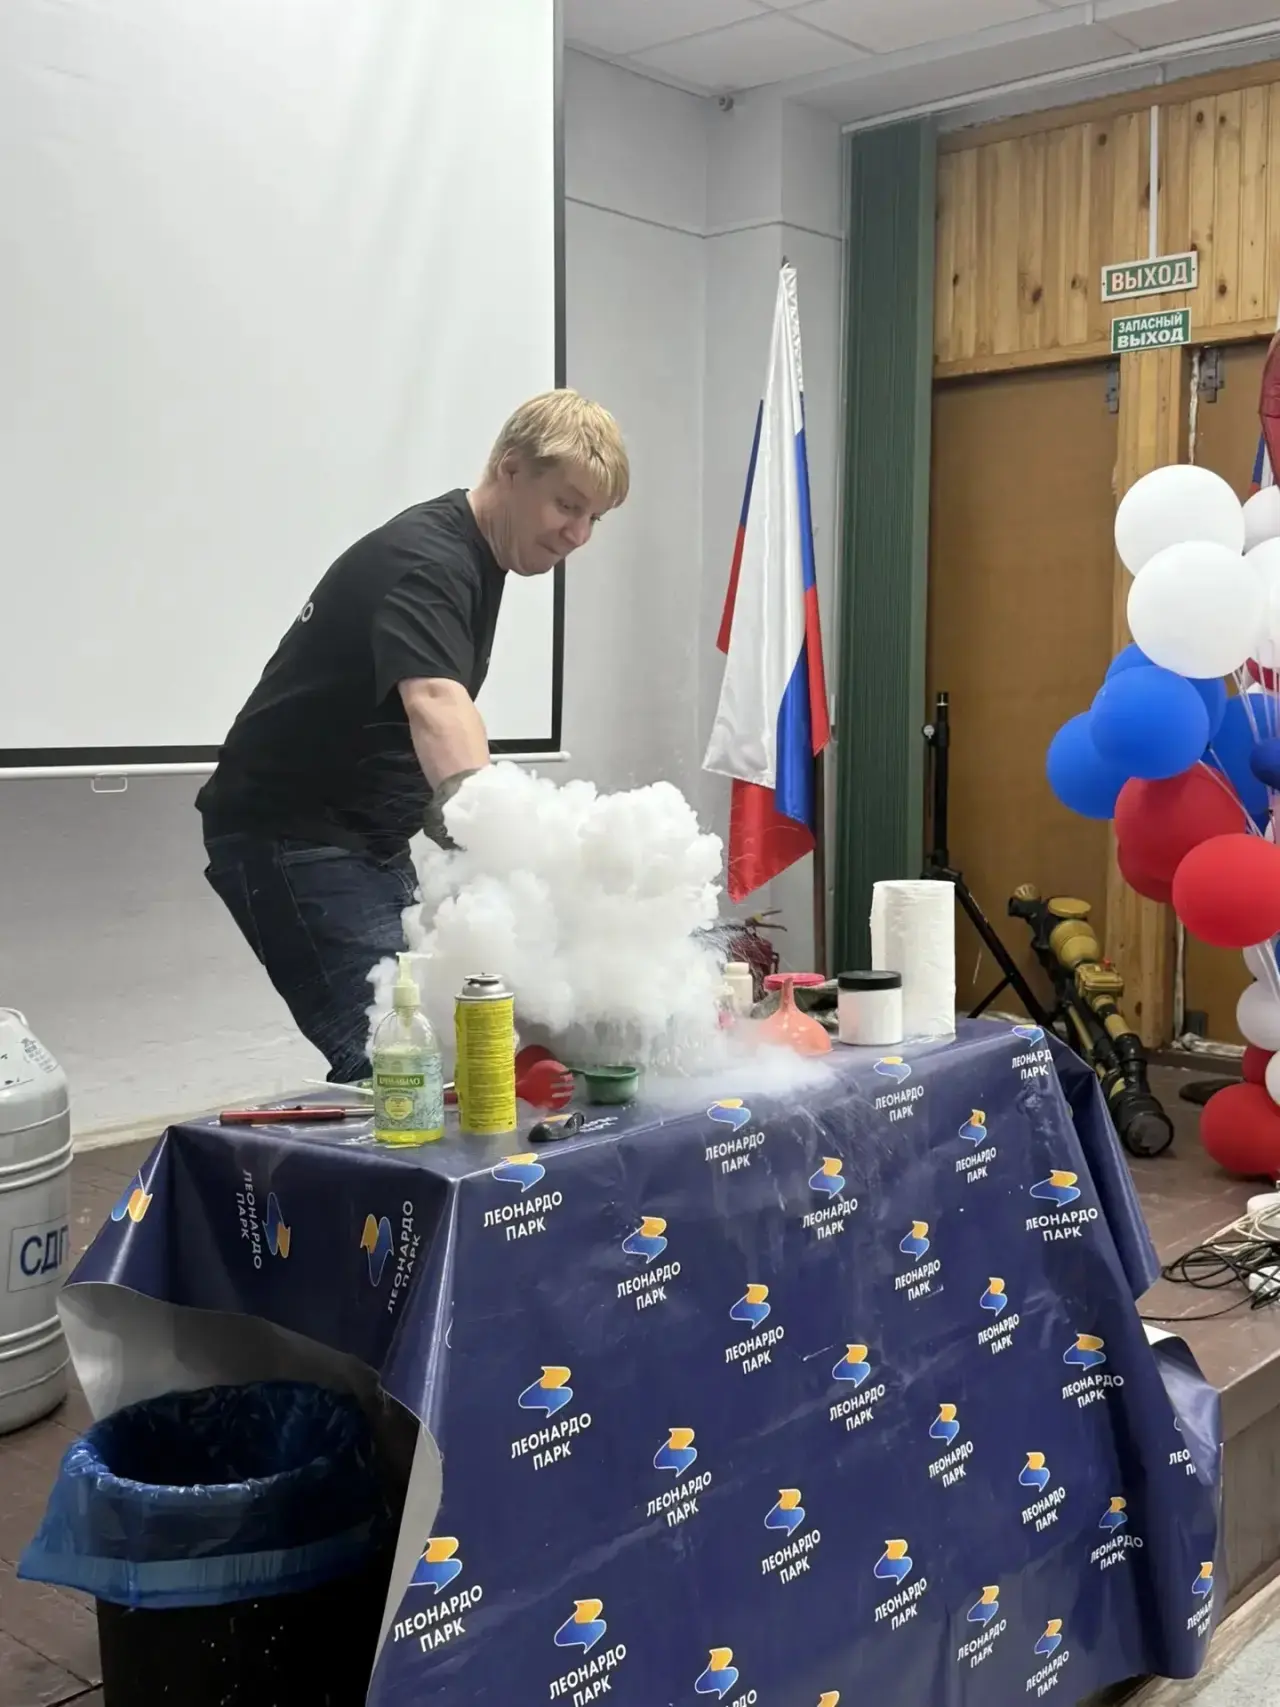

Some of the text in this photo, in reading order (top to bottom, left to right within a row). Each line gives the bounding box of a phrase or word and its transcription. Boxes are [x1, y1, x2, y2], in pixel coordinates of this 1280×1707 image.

[1111, 262, 1188, 292] ВЫХОД
[1118, 312, 1183, 334] ЗАПАСНЫЙ
[1117, 327, 1184, 349] ВЫХОД
[1020, 1064, 1049, 1080] ПАРК
[875, 1084, 925, 1111] ЛЕОНАРДО
[889, 1104, 914, 1122] ПАРК
[705, 1132, 766, 1161] ЛЕОНАРДО
[955, 1146, 997, 1173] ЛЕОНАРДО
[721, 1154, 751, 1175] ПАРК
[966, 1166, 988, 1184] ПАРК
[236, 1192, 251, 1239] ПАРК
[243, 1169, 262, 1269] ЛЕОНАРДО
[483, 1190, 563, 1228] ЛЕОНАРДО
[802, 1198, 859, 1228] ЛЕОНАРДО
[1025, 1208, 1099, 1231] ЛЕОНАРДО
[506, 1216, 546, 1242] ПАРК
[817, 1219, 845, 1240] ПАРК
[1042, 1225, 1082, 1242] ПАРК
[387, 1200, 414, 1314] ЛЕОНАРДО
[402, 1233, 421, 1288] ПАРК
[617, 1261, 682, 1298] ЛЕОНАРДО
[894, 1259, 941, 1291] ЛЕОНАРДО
[636, 1286, 667, 1311] ПАРК
[908, 1280, 931, 1302] ПАРК
[978, 1314, 1020, 1345] ЛЕОНАРДО
[724, 1326, 785, 1363] ЛЕОНАРДО
[991, 1334, 1013, 1355] ПАРК
[742, 1350, 772, 1375] ПАРК
[1062, 1374, 1125, 1400] ЛЕОНАРДО
[1077, 1388, 1106, 1408] ПАРК
[829, 1384, 886, 1421] ЛЕОНАРДО
[845, 1407, 874, 1432] ПАРК
[510, 1412, 592, 1459] ЛЕОНАРДО
[533, 1441, 571, 1471] ПАРК
[928, 1441, 974, 1479] ЛЕОНАРДО
[942, 1463, 967, 1488] ПАРК
[646, 1471, 713, 1518] ЛЕОНАРДО
[1022, 1486, 1066, 1525] ЛЕОНАРДО
[666, 1497, 699, 1528] ПАРК
[1035, 1508, 1059, 1532] ПАРК
[761, 1530, 821, 1575] ЛЕОНАРДО
[1090, 1535, 1143, 1564] ЛЕОНАРДО
[1099, 1549, 1126, 1571] ПАРК
[780, 1556, 811, 1586] ПАРК
[393, 1585, 483, 1643] ЛЕОНАРДО
[874, 1577, 928, 1622] ЛЕОНАРДО
[890, 1603, 918, 1631] ПАРК
[419, 1616, 466, 1653] ПАРК
[957, 1618, 1007, 1662] ЛЕОНАРДО
[969, 1642, 994, 1668] ПАРК
[549, 1643, 627, 1700] ЛЕОНАРДО
[1026, 1650, 1070, 1692] ЛЕОНАРДО
[1037, 1671, 1059, 1698] ПАРК
[572, 1674, 612, 1707] ПАРК
